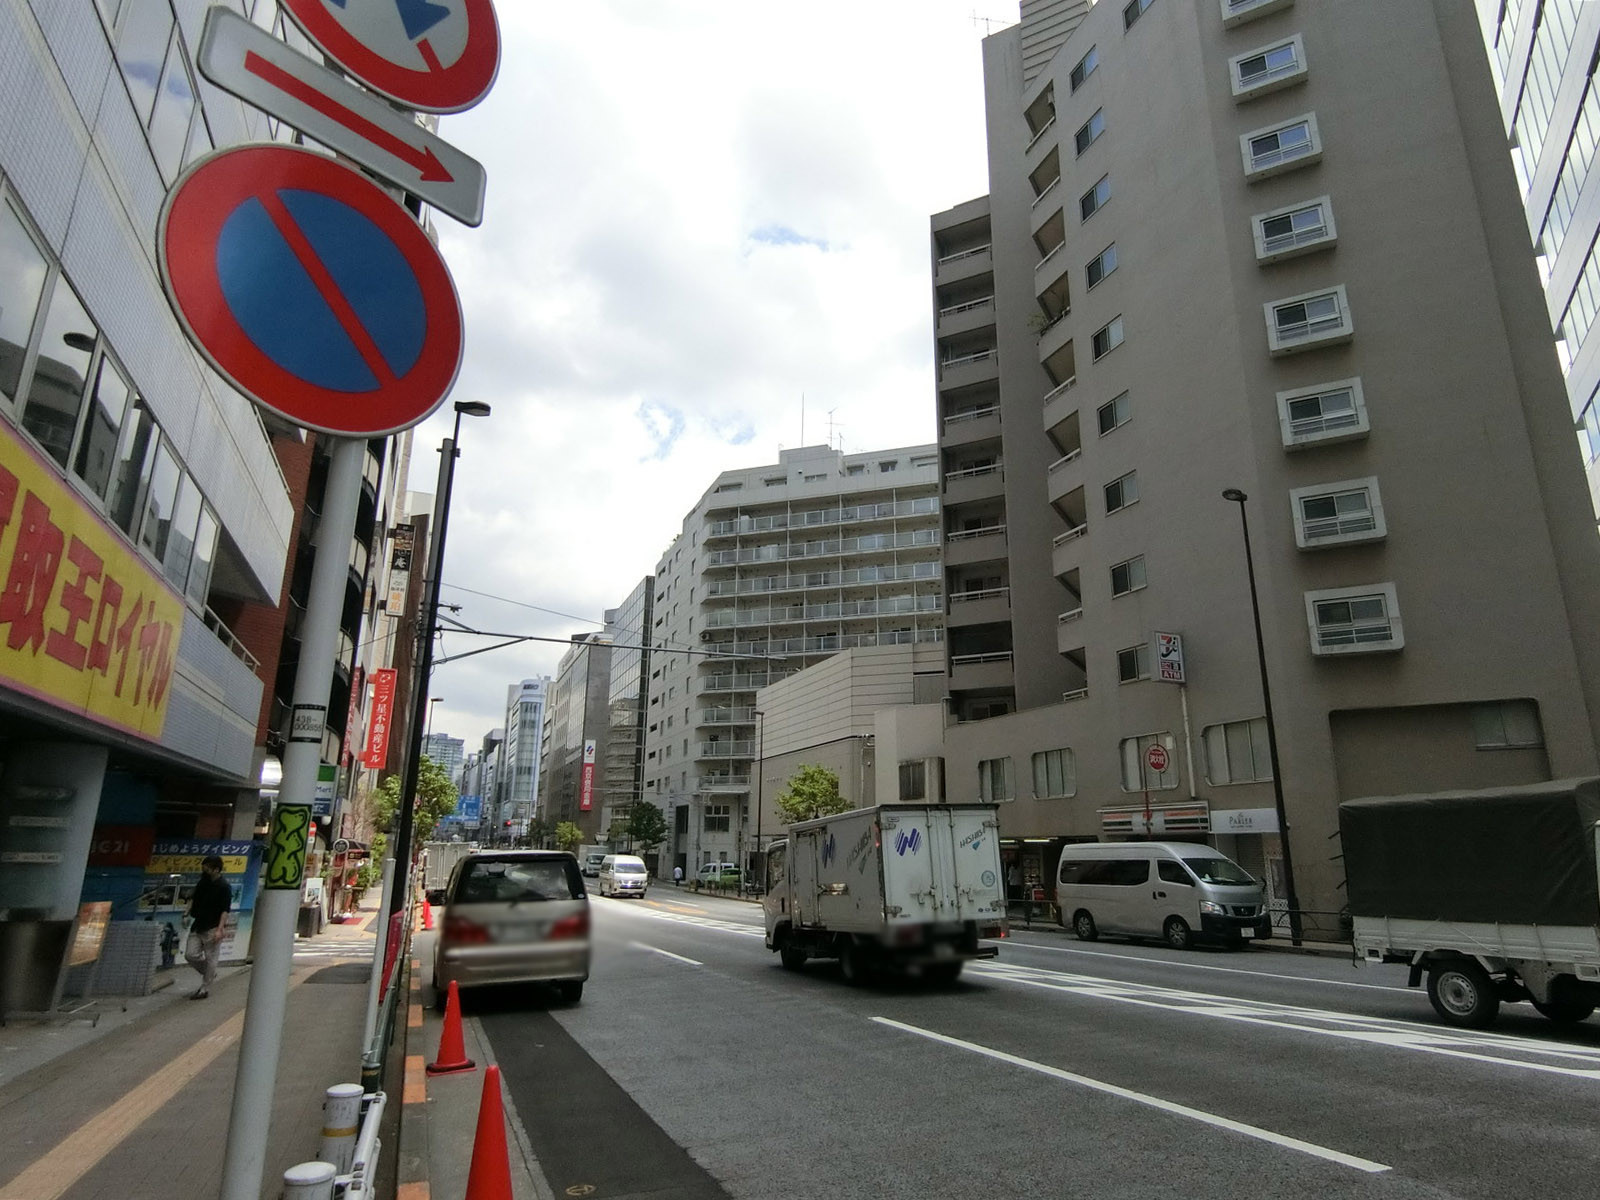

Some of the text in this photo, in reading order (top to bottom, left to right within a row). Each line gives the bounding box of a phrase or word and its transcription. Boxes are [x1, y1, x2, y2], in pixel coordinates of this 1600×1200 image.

[0, 463, 174, 712] 取王ロイヤル
[1164, 670, 1181, 680] ATM
[370, 684, 390, 763] 三ツ星不動産ビル
